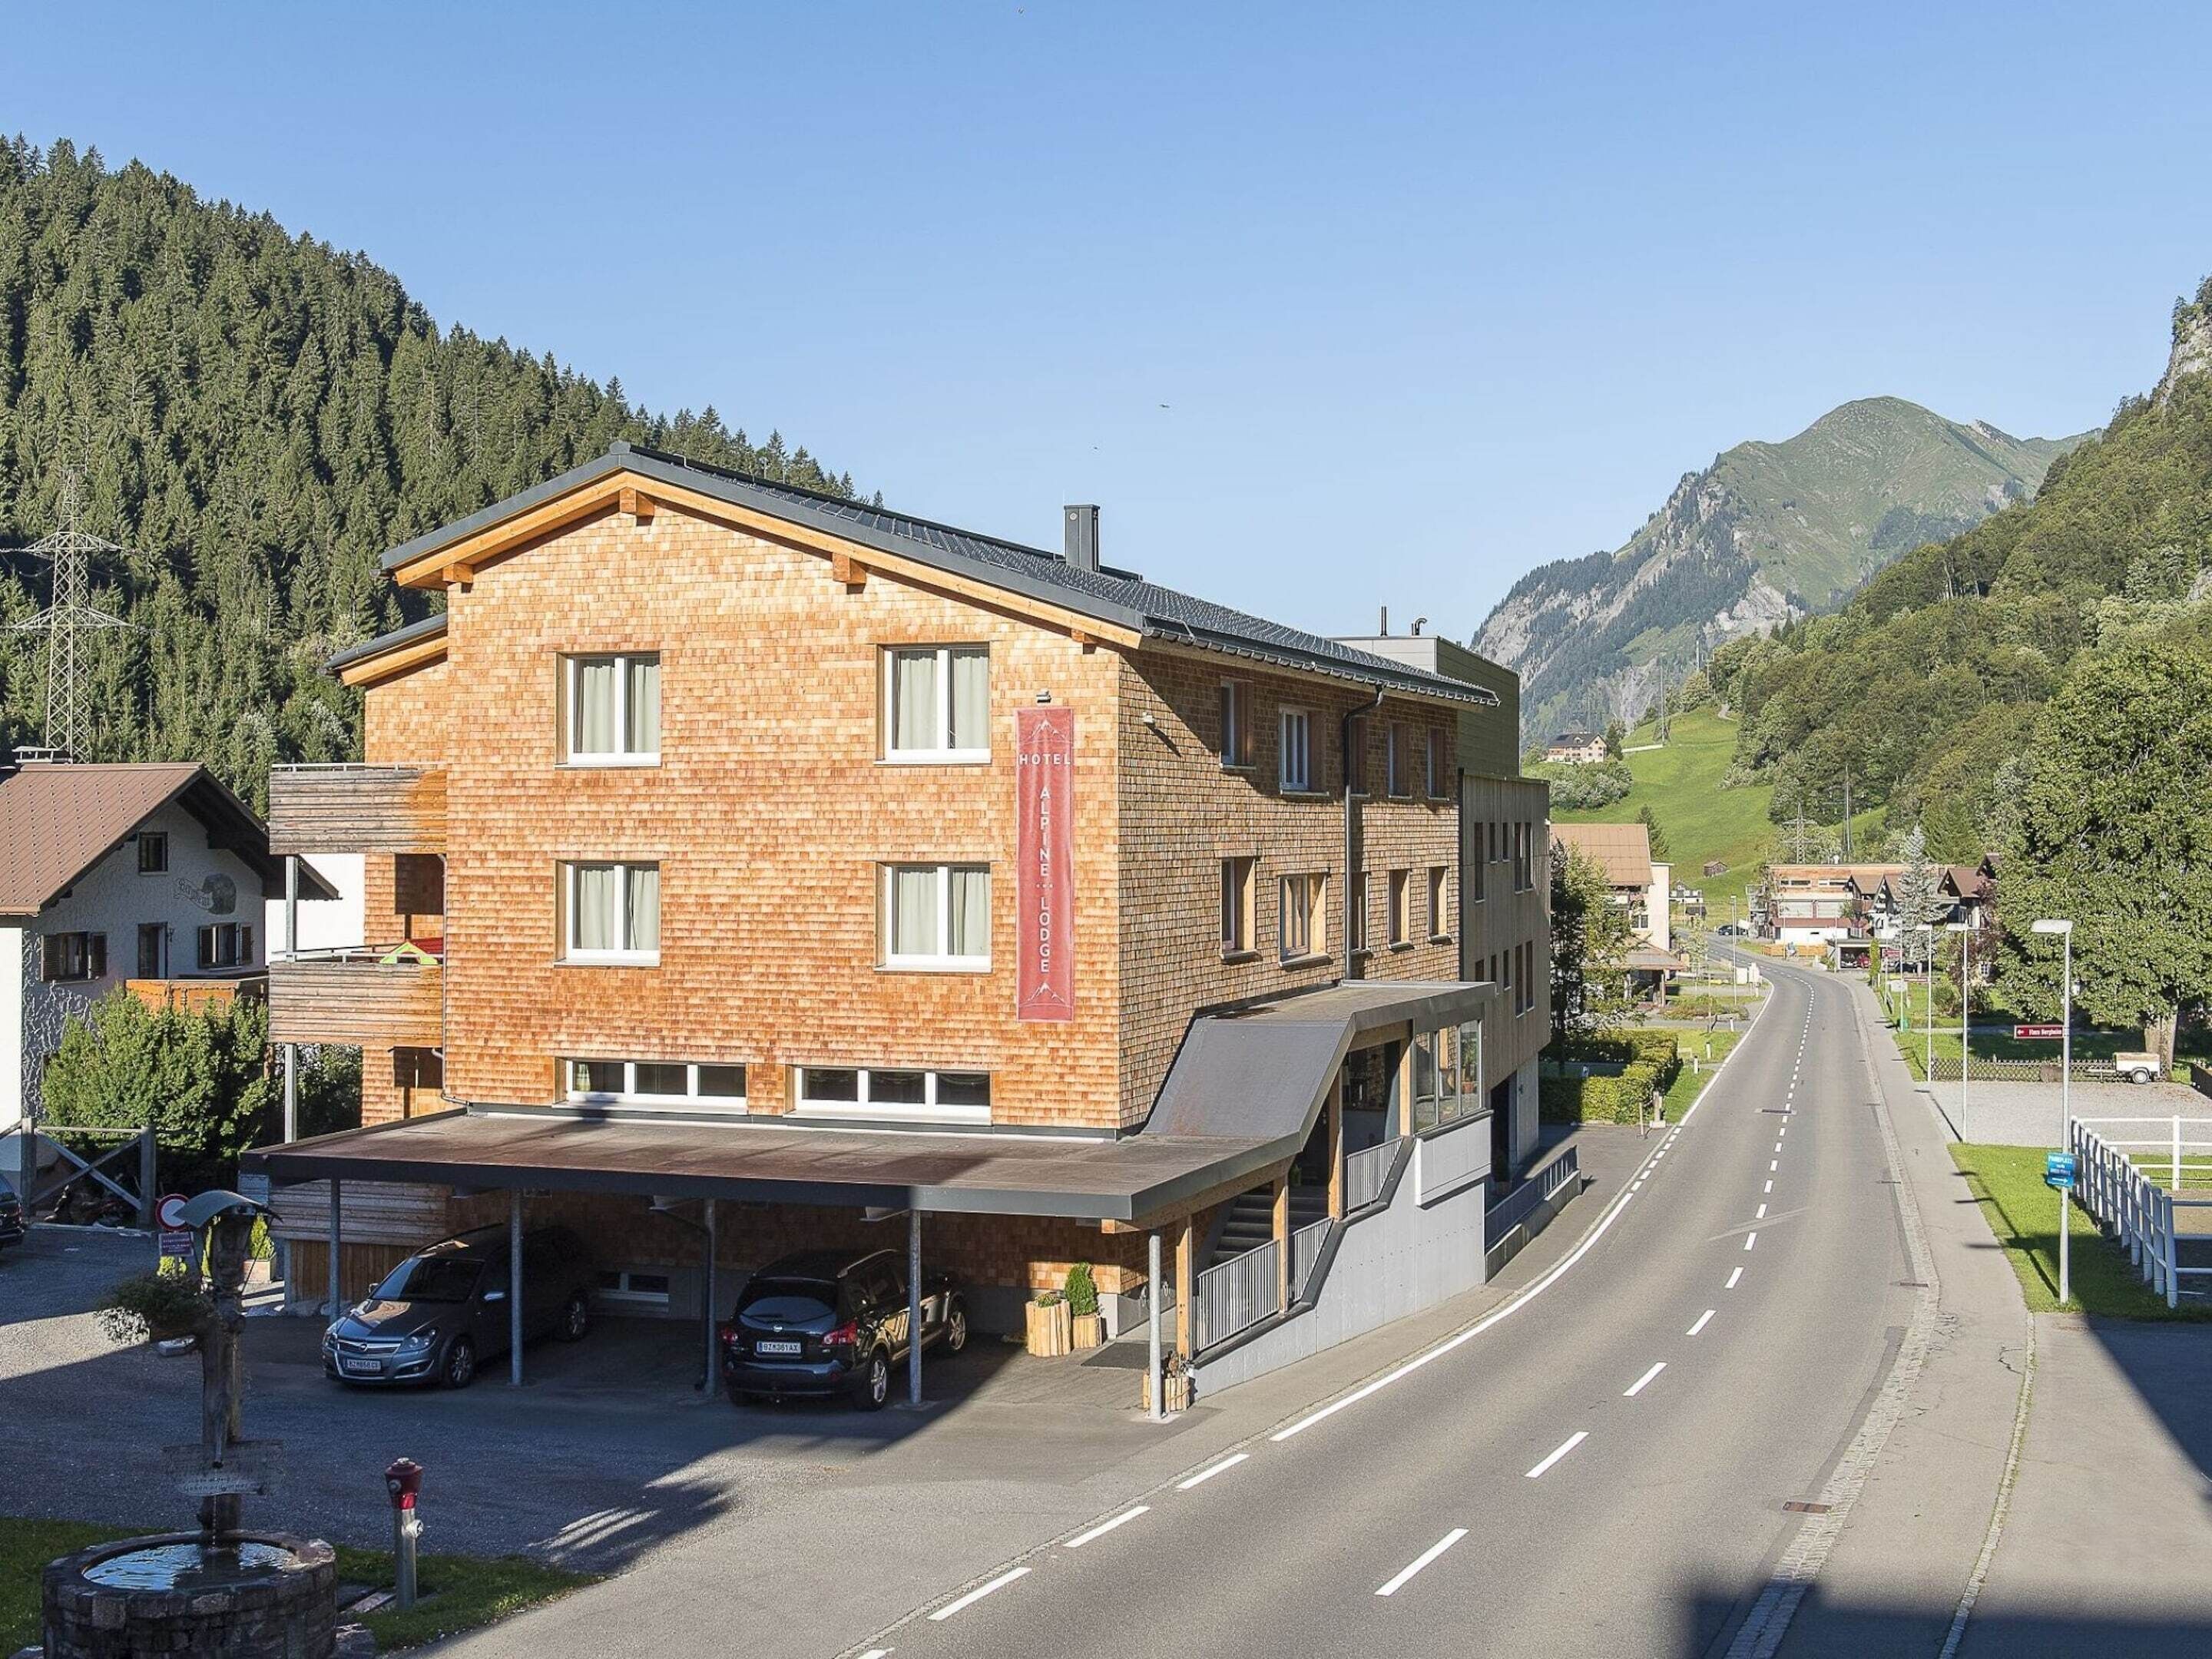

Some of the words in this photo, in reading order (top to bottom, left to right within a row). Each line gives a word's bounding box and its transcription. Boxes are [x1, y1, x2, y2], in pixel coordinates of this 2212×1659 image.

[1019, 753, 1071, 765] HOTEL
[1039, 786, 1051, 876] ALPINE
[1039, 896, 1051, 973] LODGE
